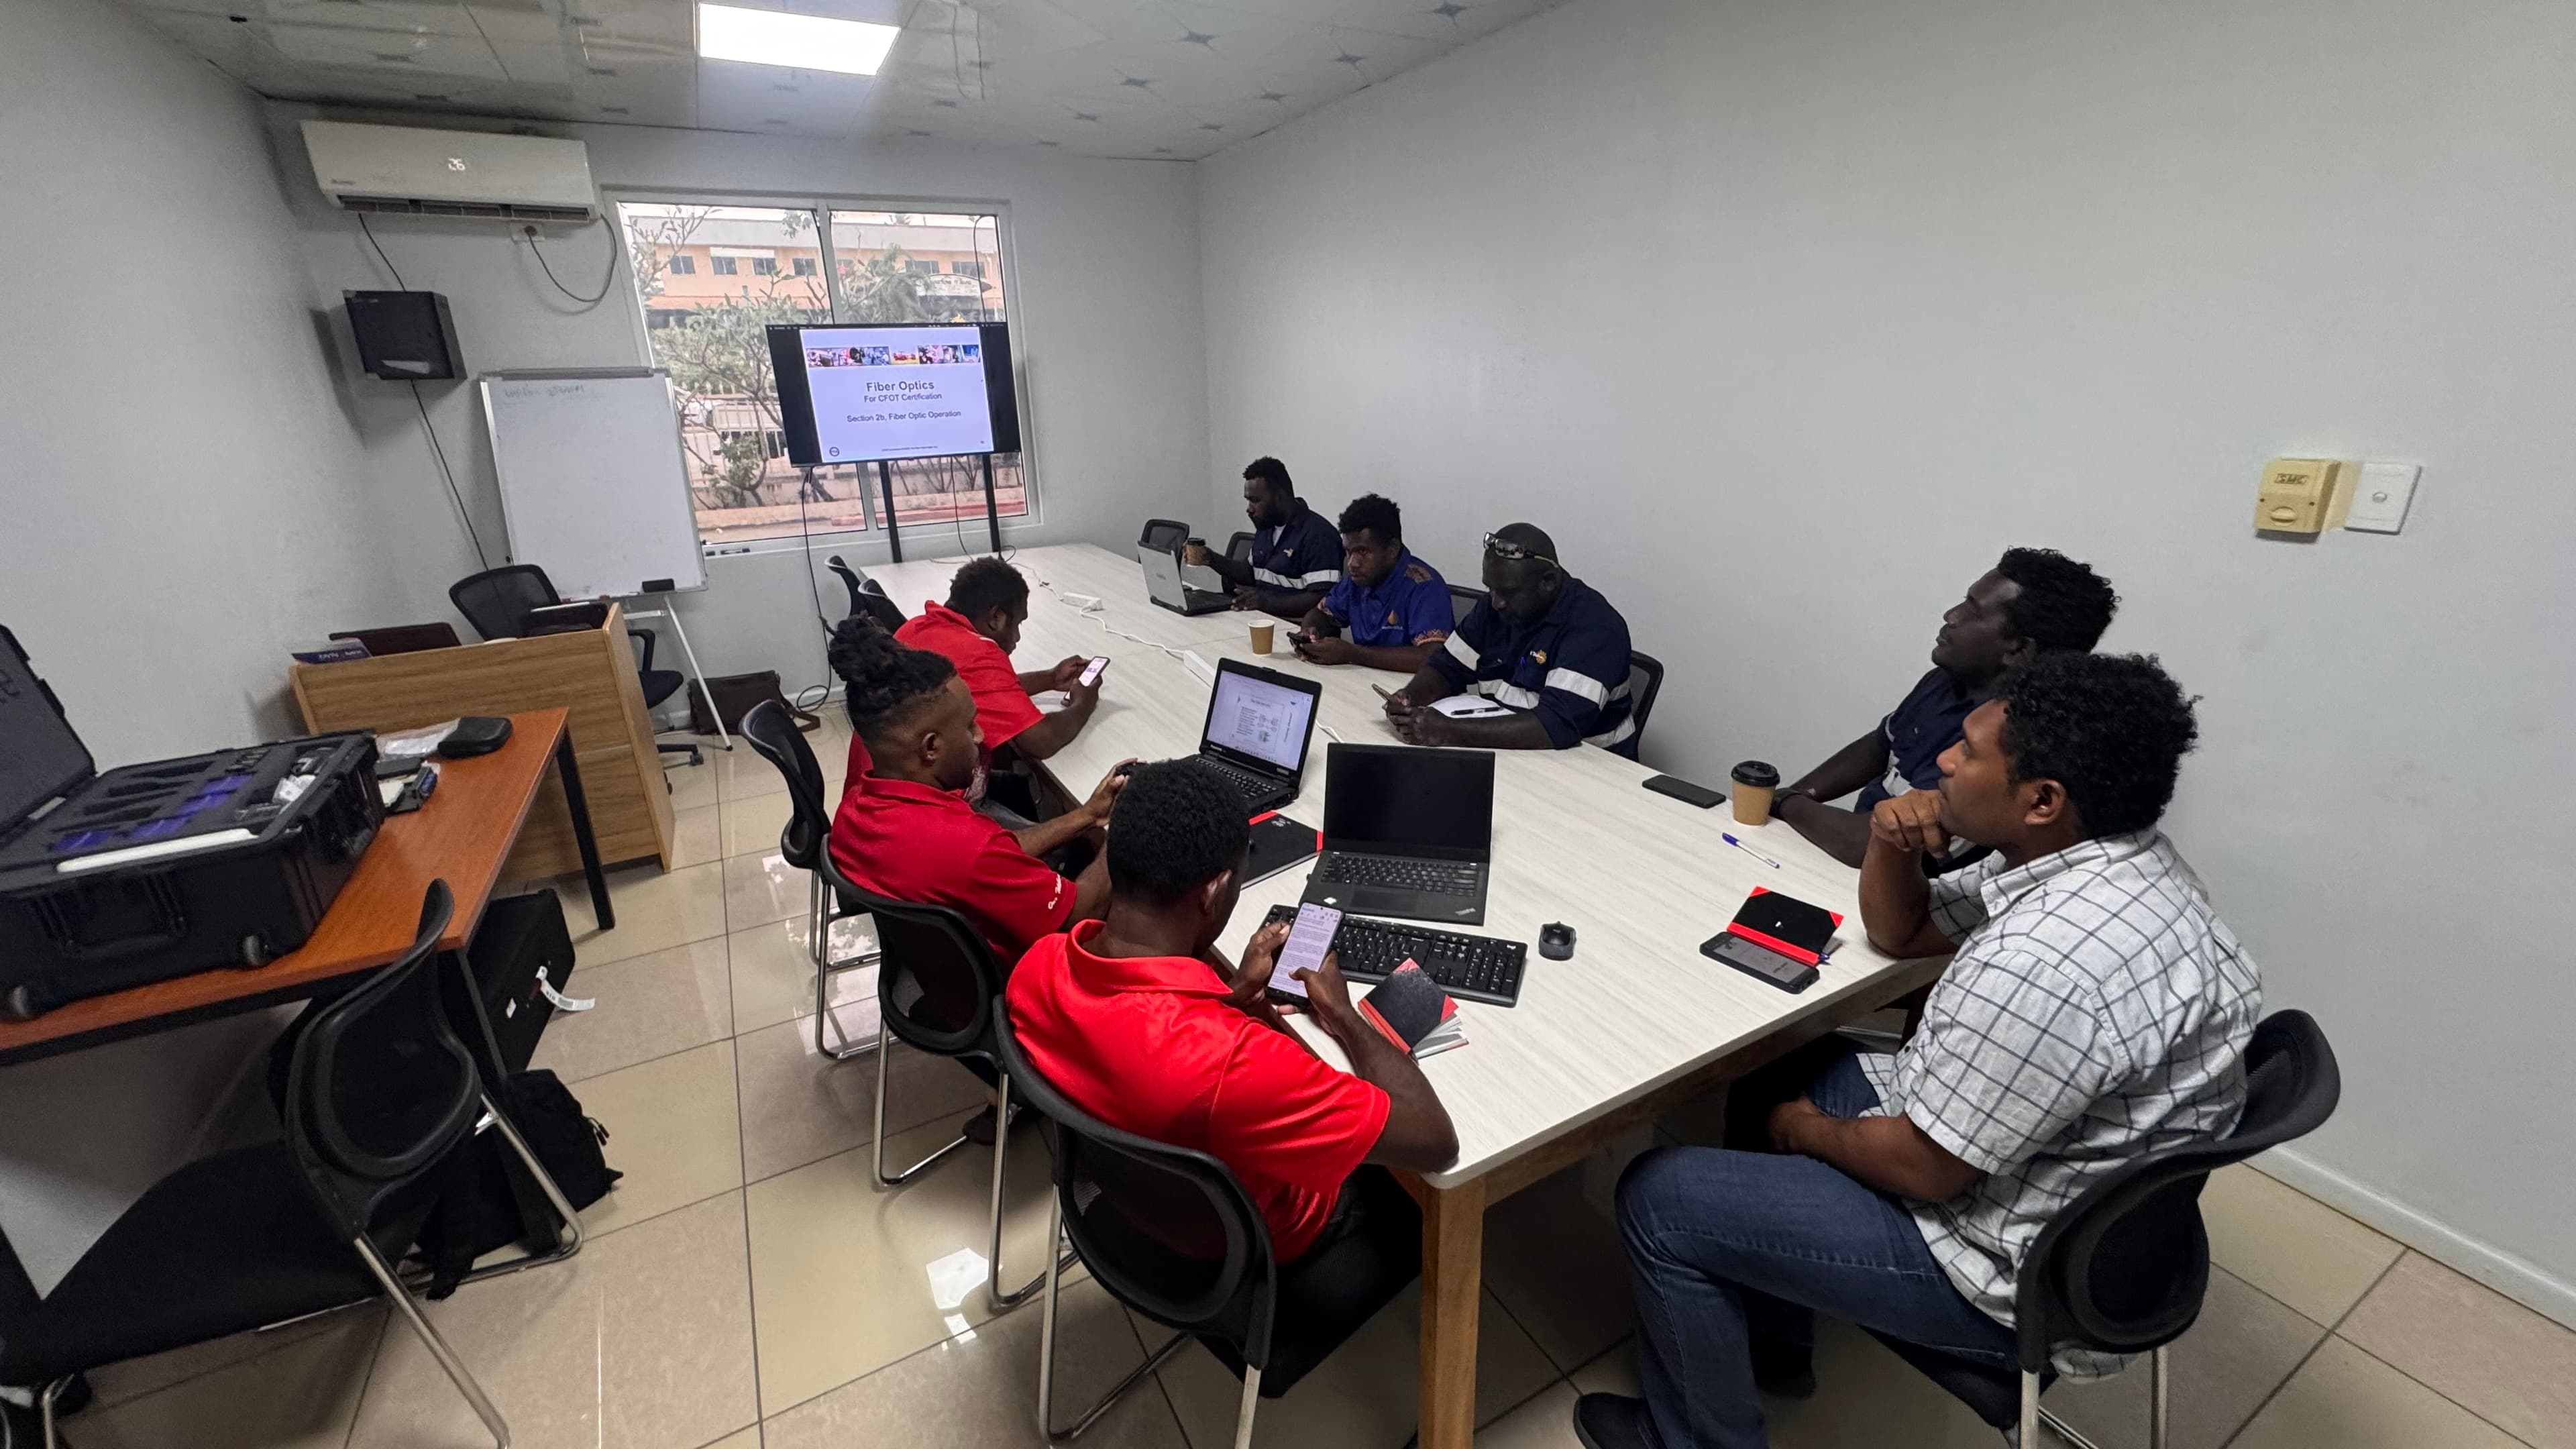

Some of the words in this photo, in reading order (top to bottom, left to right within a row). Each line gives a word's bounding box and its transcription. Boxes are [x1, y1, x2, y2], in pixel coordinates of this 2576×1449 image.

[447, 157, 466, 171] 26
[866, 382, 896, 392] Fiber
[899, 380, 934, 392] Optics
[877, 394, 900, 402] CFOT
[901, 393, 942, 401] Certification
[847, 415, 874, 423] Section
[875, 413, 887, 421] 2b,
[908, 412, 926, 421] Optic
[928, 411, 961, 419] Operation
